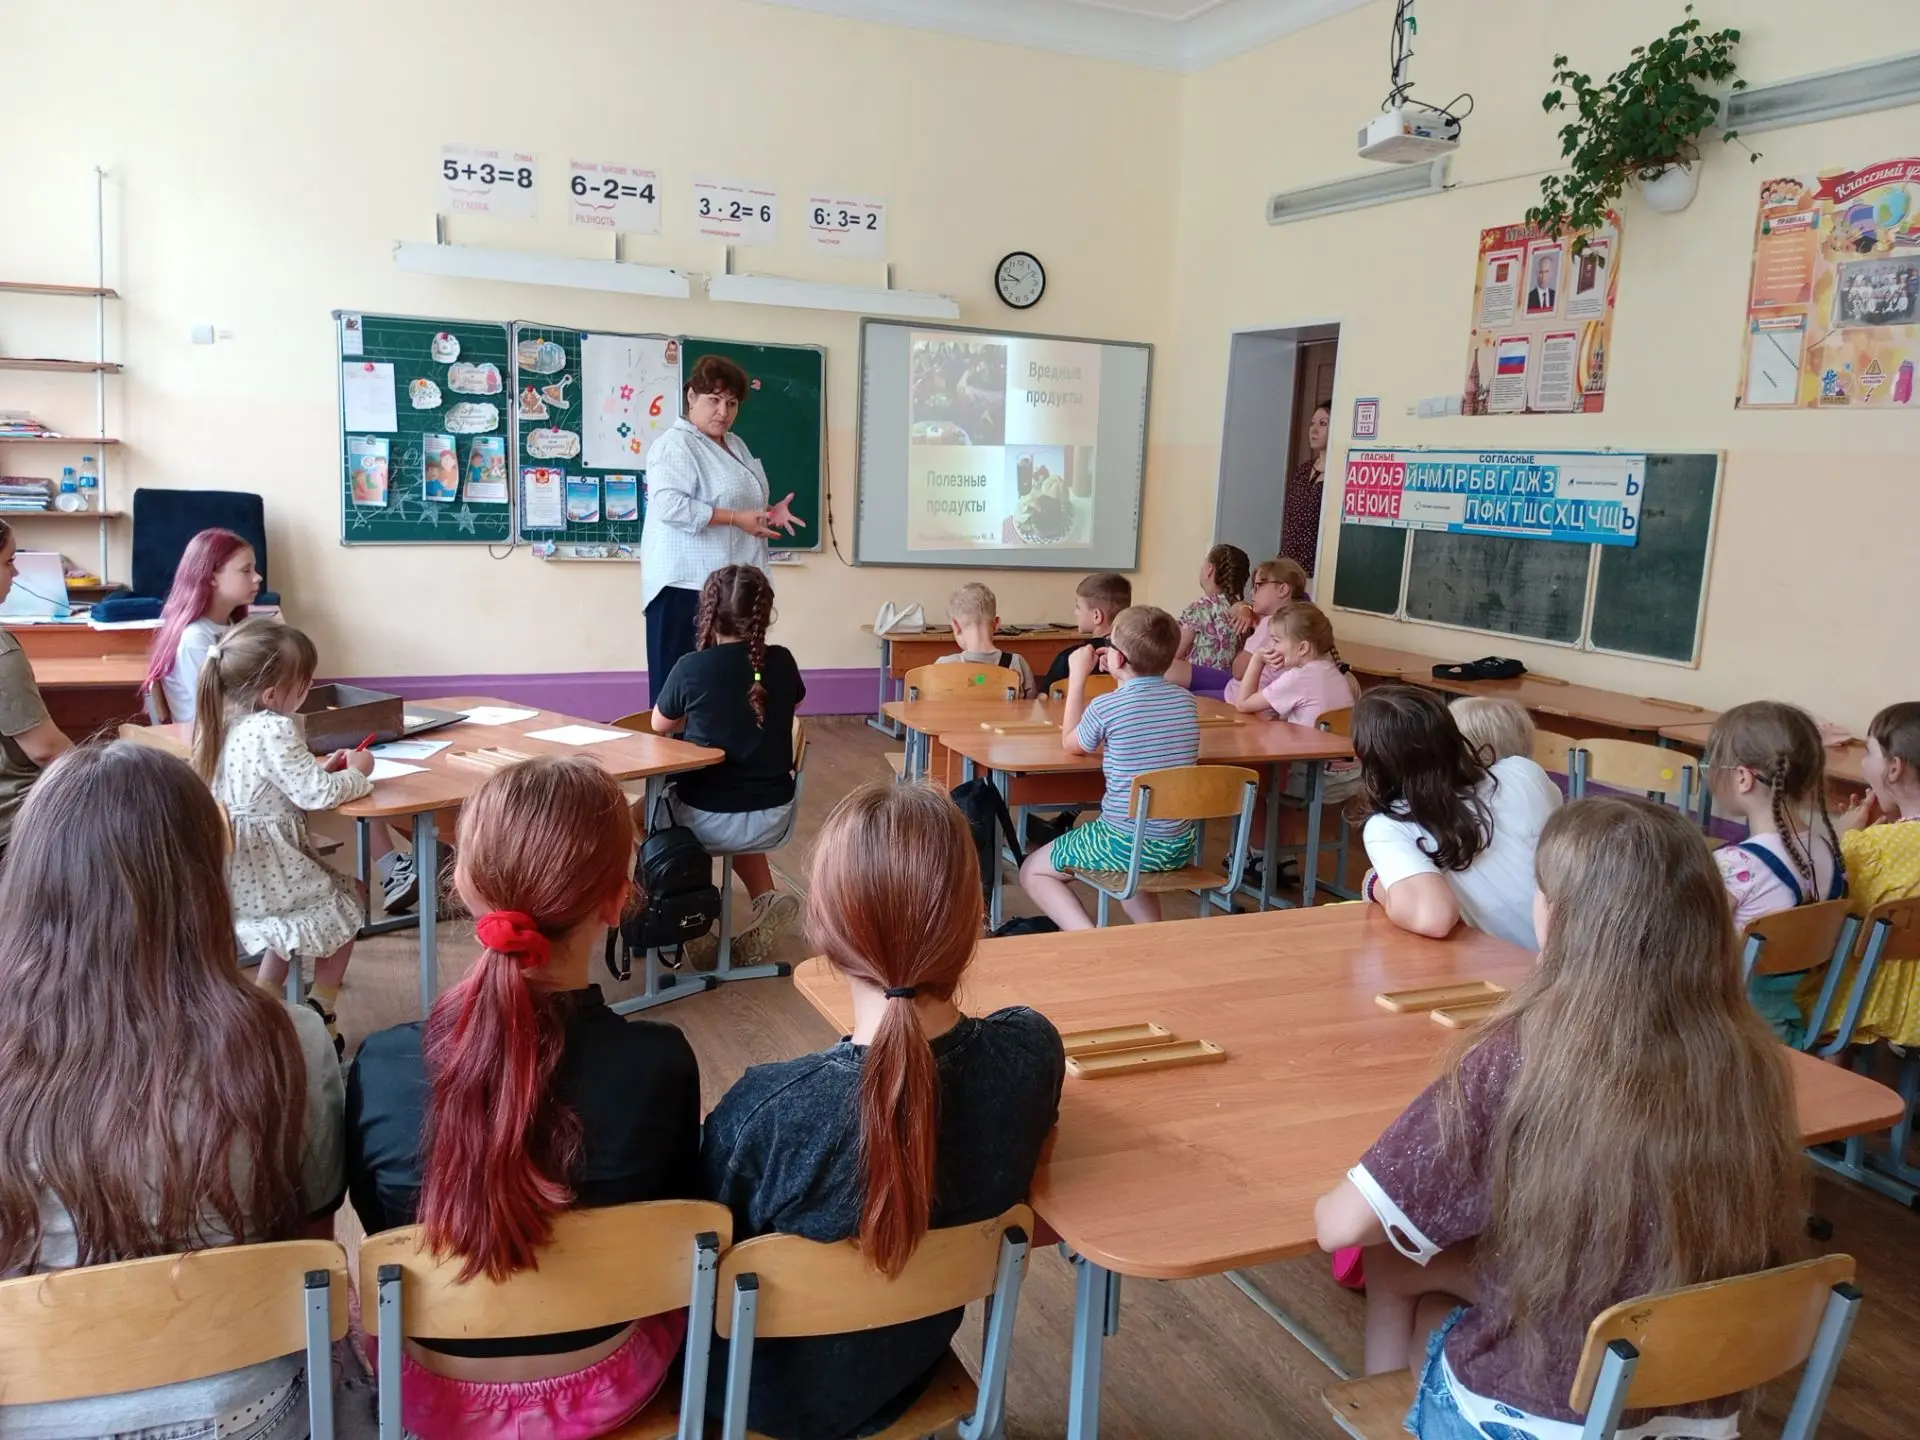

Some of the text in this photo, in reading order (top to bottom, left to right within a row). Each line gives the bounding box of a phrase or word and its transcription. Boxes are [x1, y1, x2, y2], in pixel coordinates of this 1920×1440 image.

[443, 159, 532, 188] 5+3=8
[1835, 163, 1904, 198] Классный
[571, 175, 655, 204] 6-2=4
[575, 214, 616, 226] РАЗНОСТЬ
[1029, 362, 1082, 380] Вредные
[1026, 388, 1083, 408] продукты
[1361, 453, 1395, 462] ГЛАСНЫЕ
[1479, 455, 1534, 464] СОГЛАСНЫЕ
[926, 471, 987, 488] Полезные
[926, 498, 986, 516] продукты
